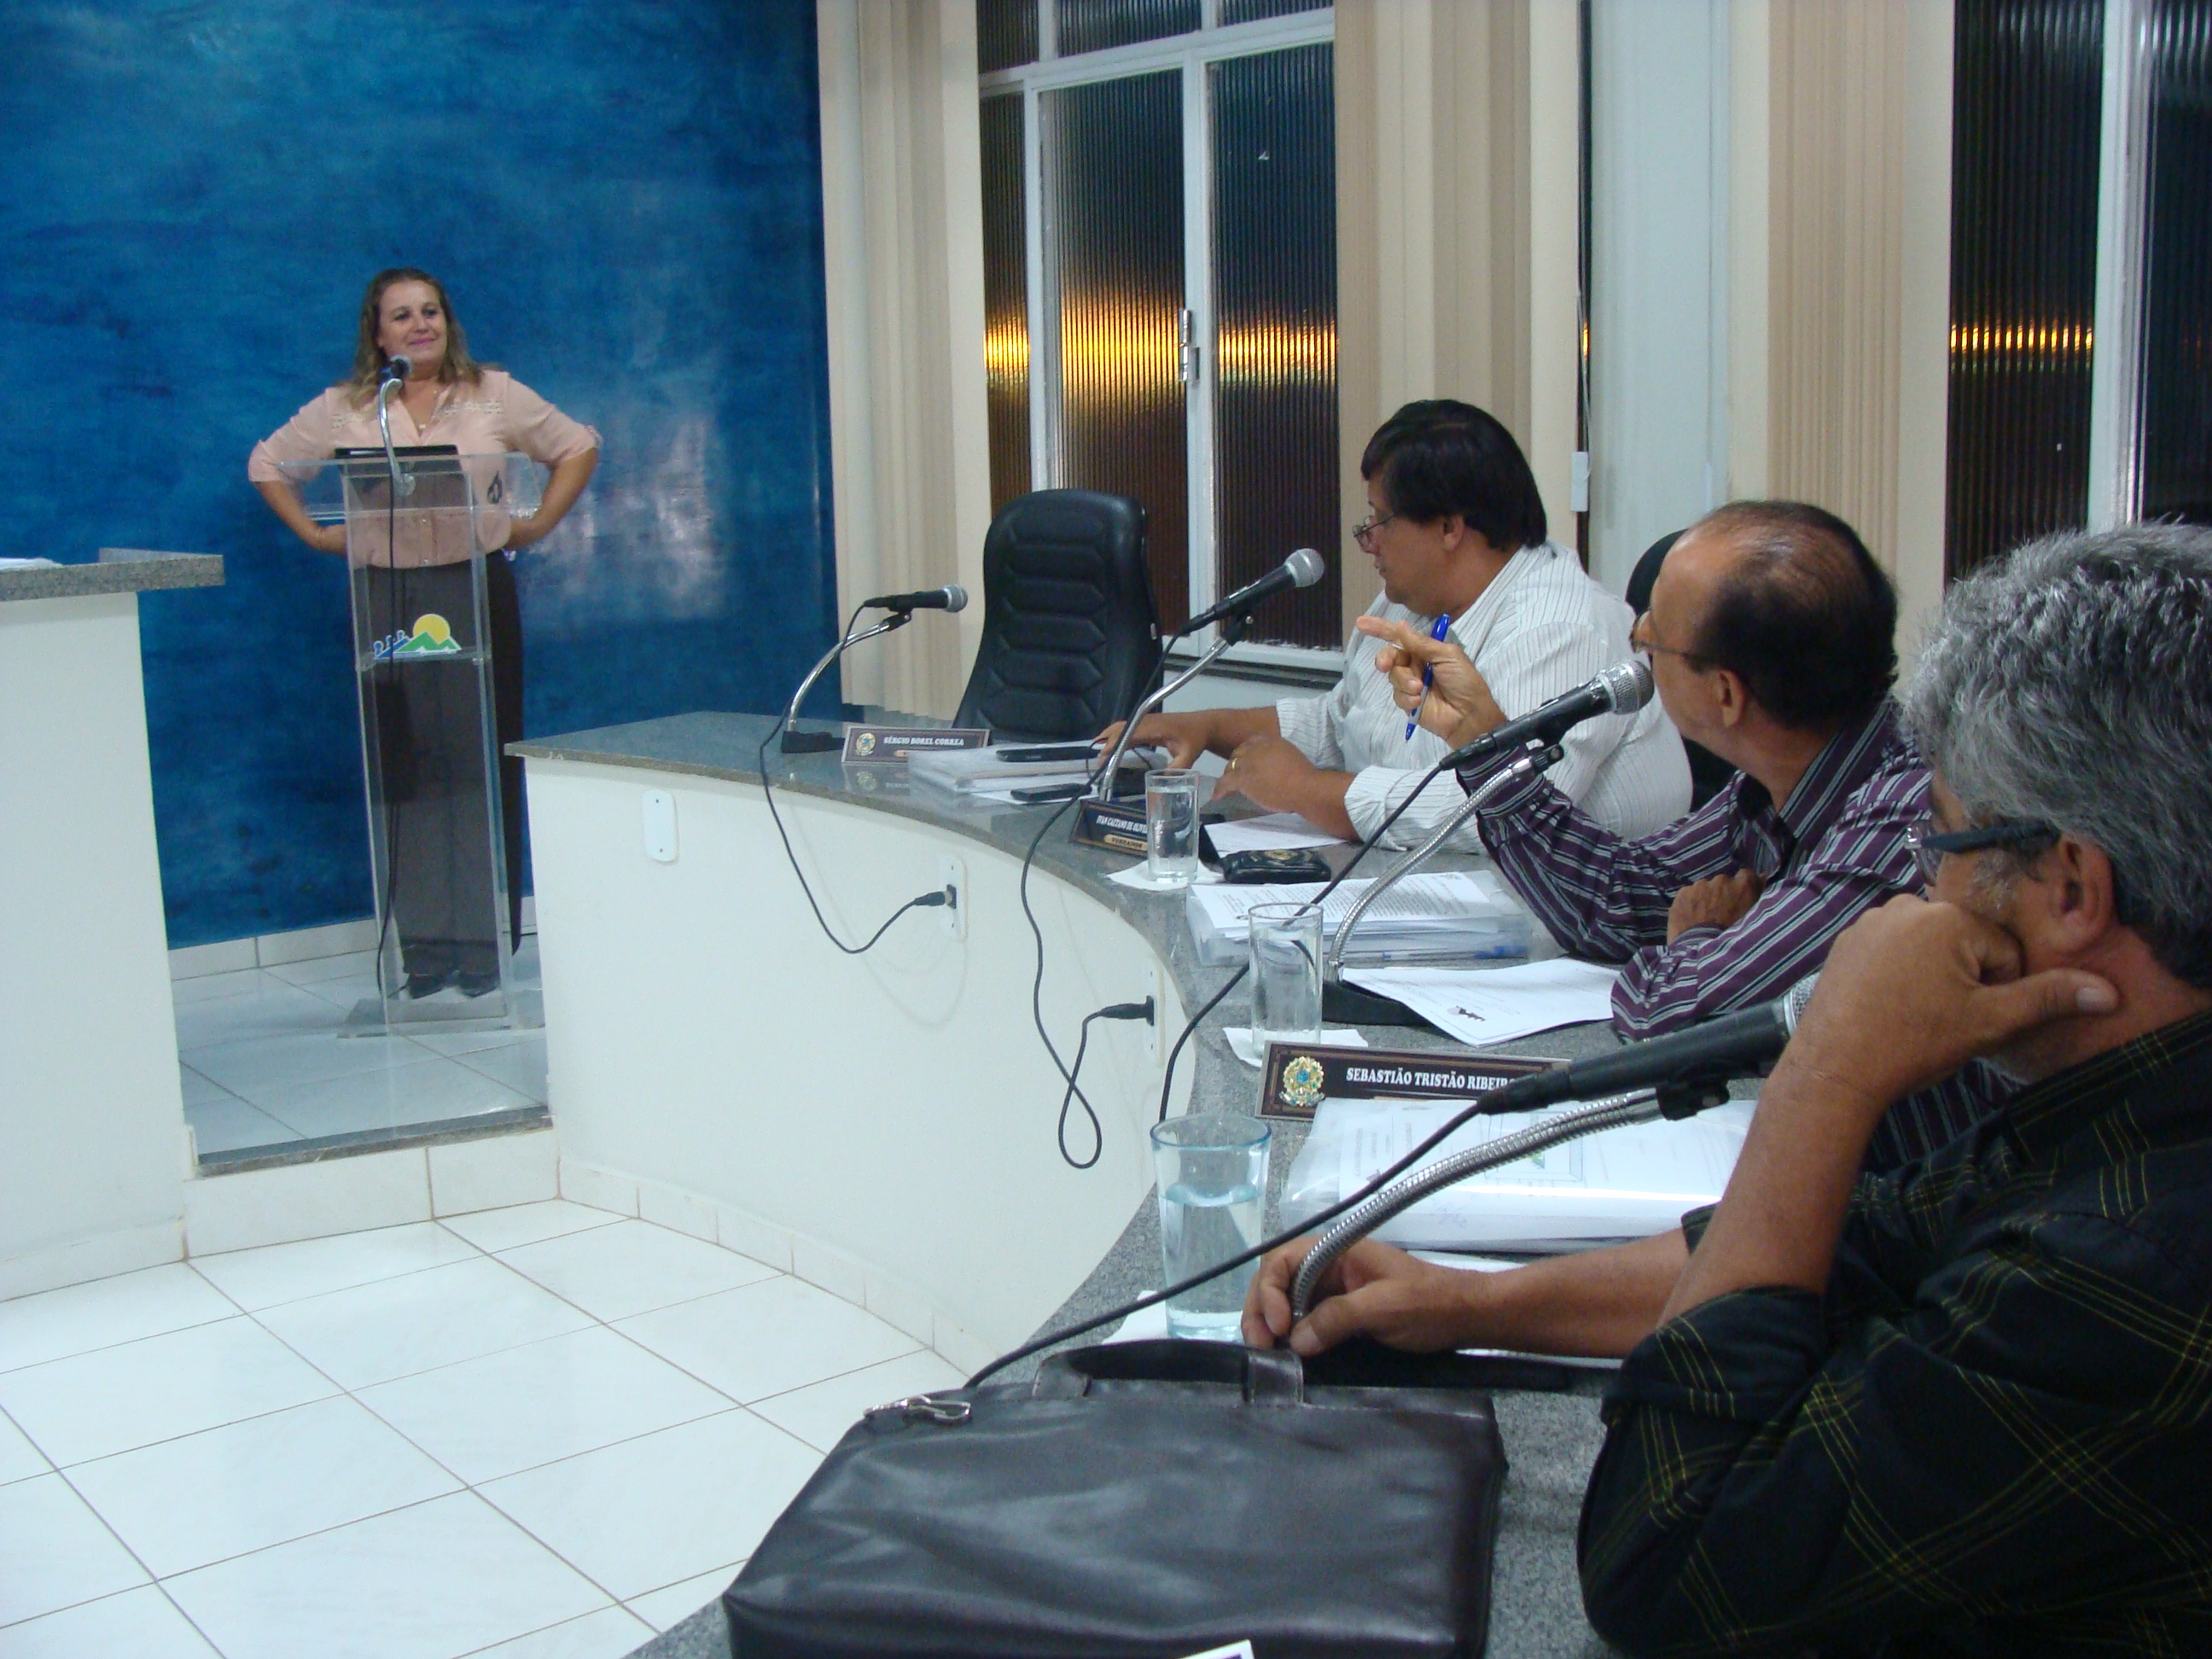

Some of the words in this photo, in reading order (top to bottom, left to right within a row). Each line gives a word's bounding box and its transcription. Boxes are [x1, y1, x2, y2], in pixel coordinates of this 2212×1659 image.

[883, 735, 910, 745] SÉRGIO
[910, 736, 934, 745] BOREL
[934, 737, 965, 746] CORREA
[1126, 821, 1134, 830] DE
[1132, 823, 1148, 834] OLIVE
[1346, 1067, 1412, 1086] SEBASTIÃO
[1414, 1070, 1466, 1090] TRISTÃO
[1466, 1075, 1516, 1091] RIBEIR
